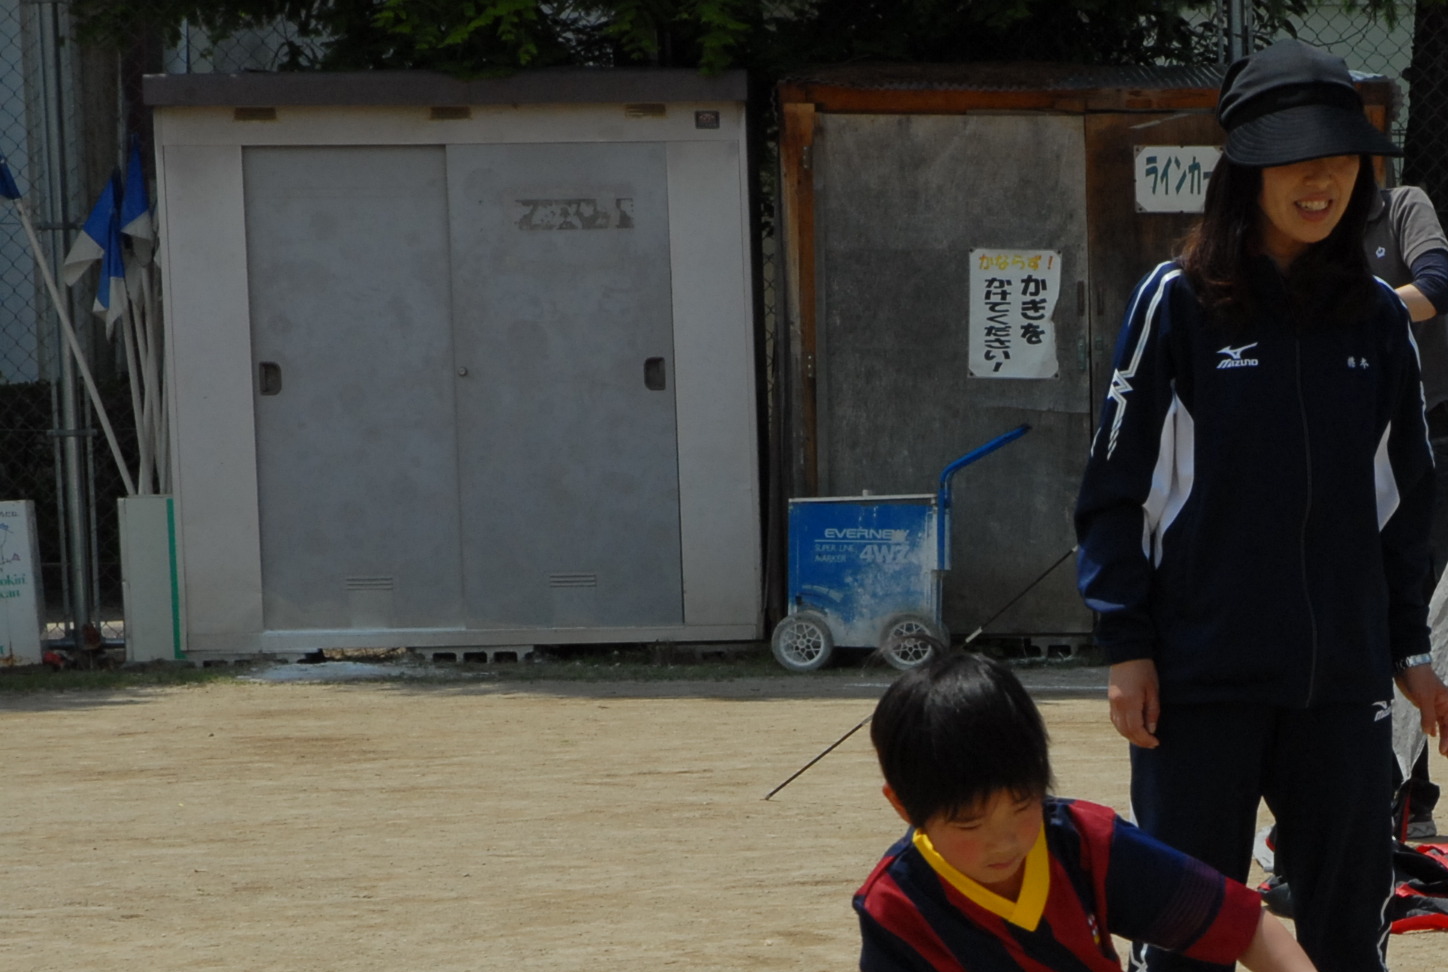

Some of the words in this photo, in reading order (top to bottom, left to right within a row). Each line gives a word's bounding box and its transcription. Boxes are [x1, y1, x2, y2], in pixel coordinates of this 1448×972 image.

[1145, 156, 1213, 195] ラインカー
[1216, 358, 1259, 369] MIZUNO
